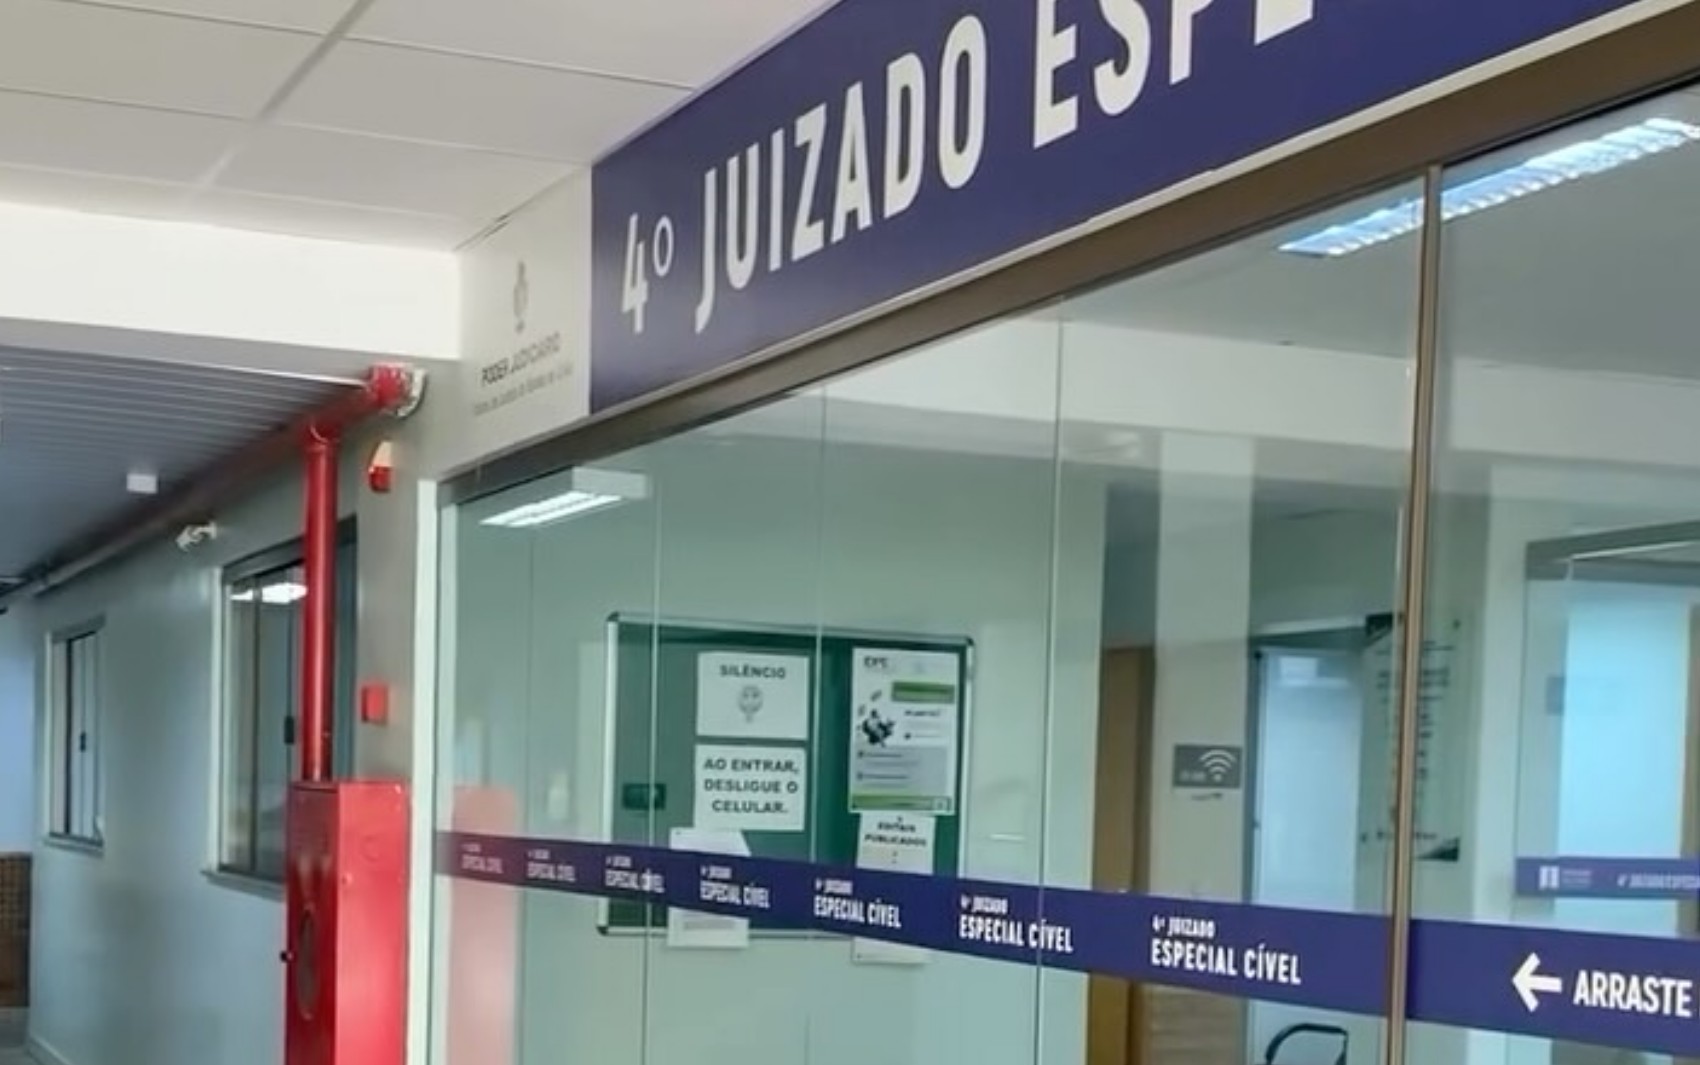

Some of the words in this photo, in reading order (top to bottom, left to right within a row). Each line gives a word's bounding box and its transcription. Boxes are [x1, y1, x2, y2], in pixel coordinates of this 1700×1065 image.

[695, 15, 989, 334] JUIZADO
[1033, 0, 1313, 149] ES
[720, 664, 786, 679] SILÊNCIO
[704, 759, 727, 770] AO
[731, 759, 799, 774] ENTRAR,
[704, 779, 781, 793] DESLIGUE
[787, 781, 798, 793] O
[712, 800, 788, 813] CELULAR.
[813, 895, 865, 923] ESPECIAL
[867, 898, 902, 928] CÍVEL
[971, 897, 1008, 914] JUIZADO
[959, 914, 1024, 947] ESPECIAL
[1029, 919, 1073, 953] CÍVEL
[1167, 916, 1215, 939] JUIZADO
[1152, 938, 1238, 976] ESPECIAL
[1244, 943, 1301, 985] CÍVEL
[1573, 969, 1693, 1018] ARRASTE
